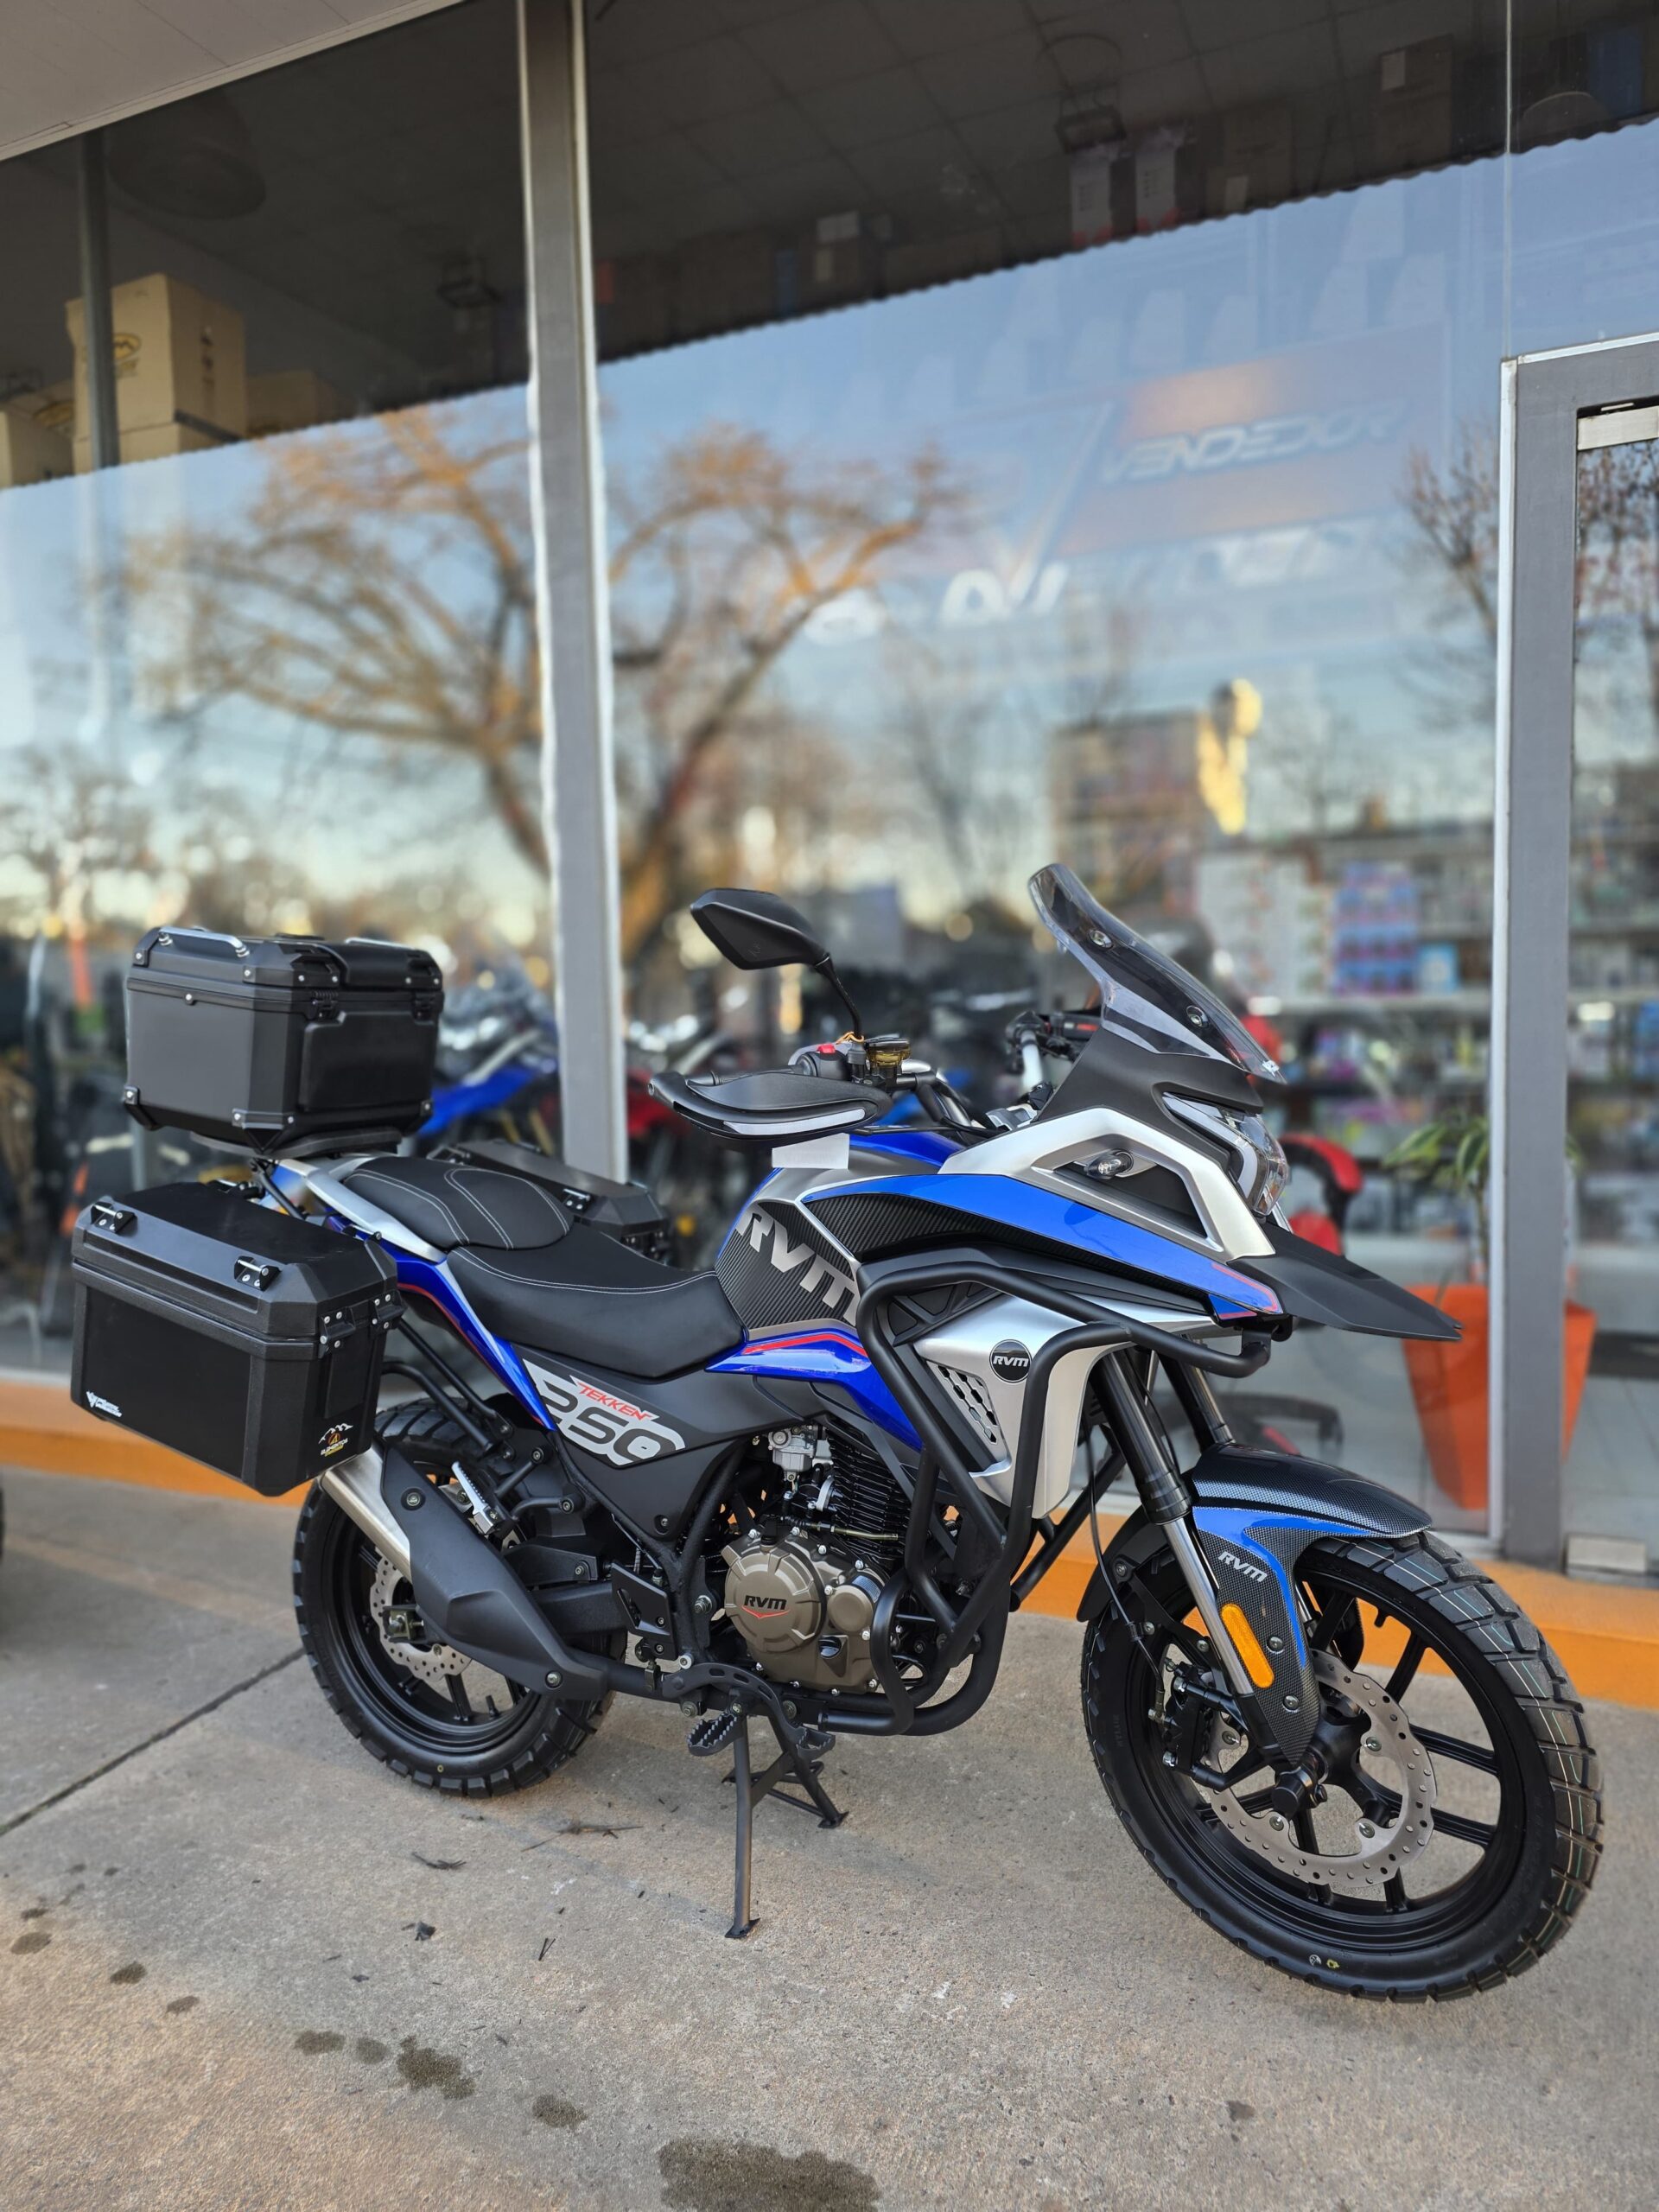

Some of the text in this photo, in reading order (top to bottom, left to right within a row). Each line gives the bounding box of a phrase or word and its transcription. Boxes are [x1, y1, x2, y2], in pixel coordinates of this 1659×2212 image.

[735, 1202, 861, 1327] RVM
[993, 1355, 1029, 1367] RVM
[576, 1382, 652, 1421] TEKKEN
[539, 1379, 677, 1462] 250
[1218, 1550, 1268, 1583] RVM
[743, 1594, 787, 1611] RVM
